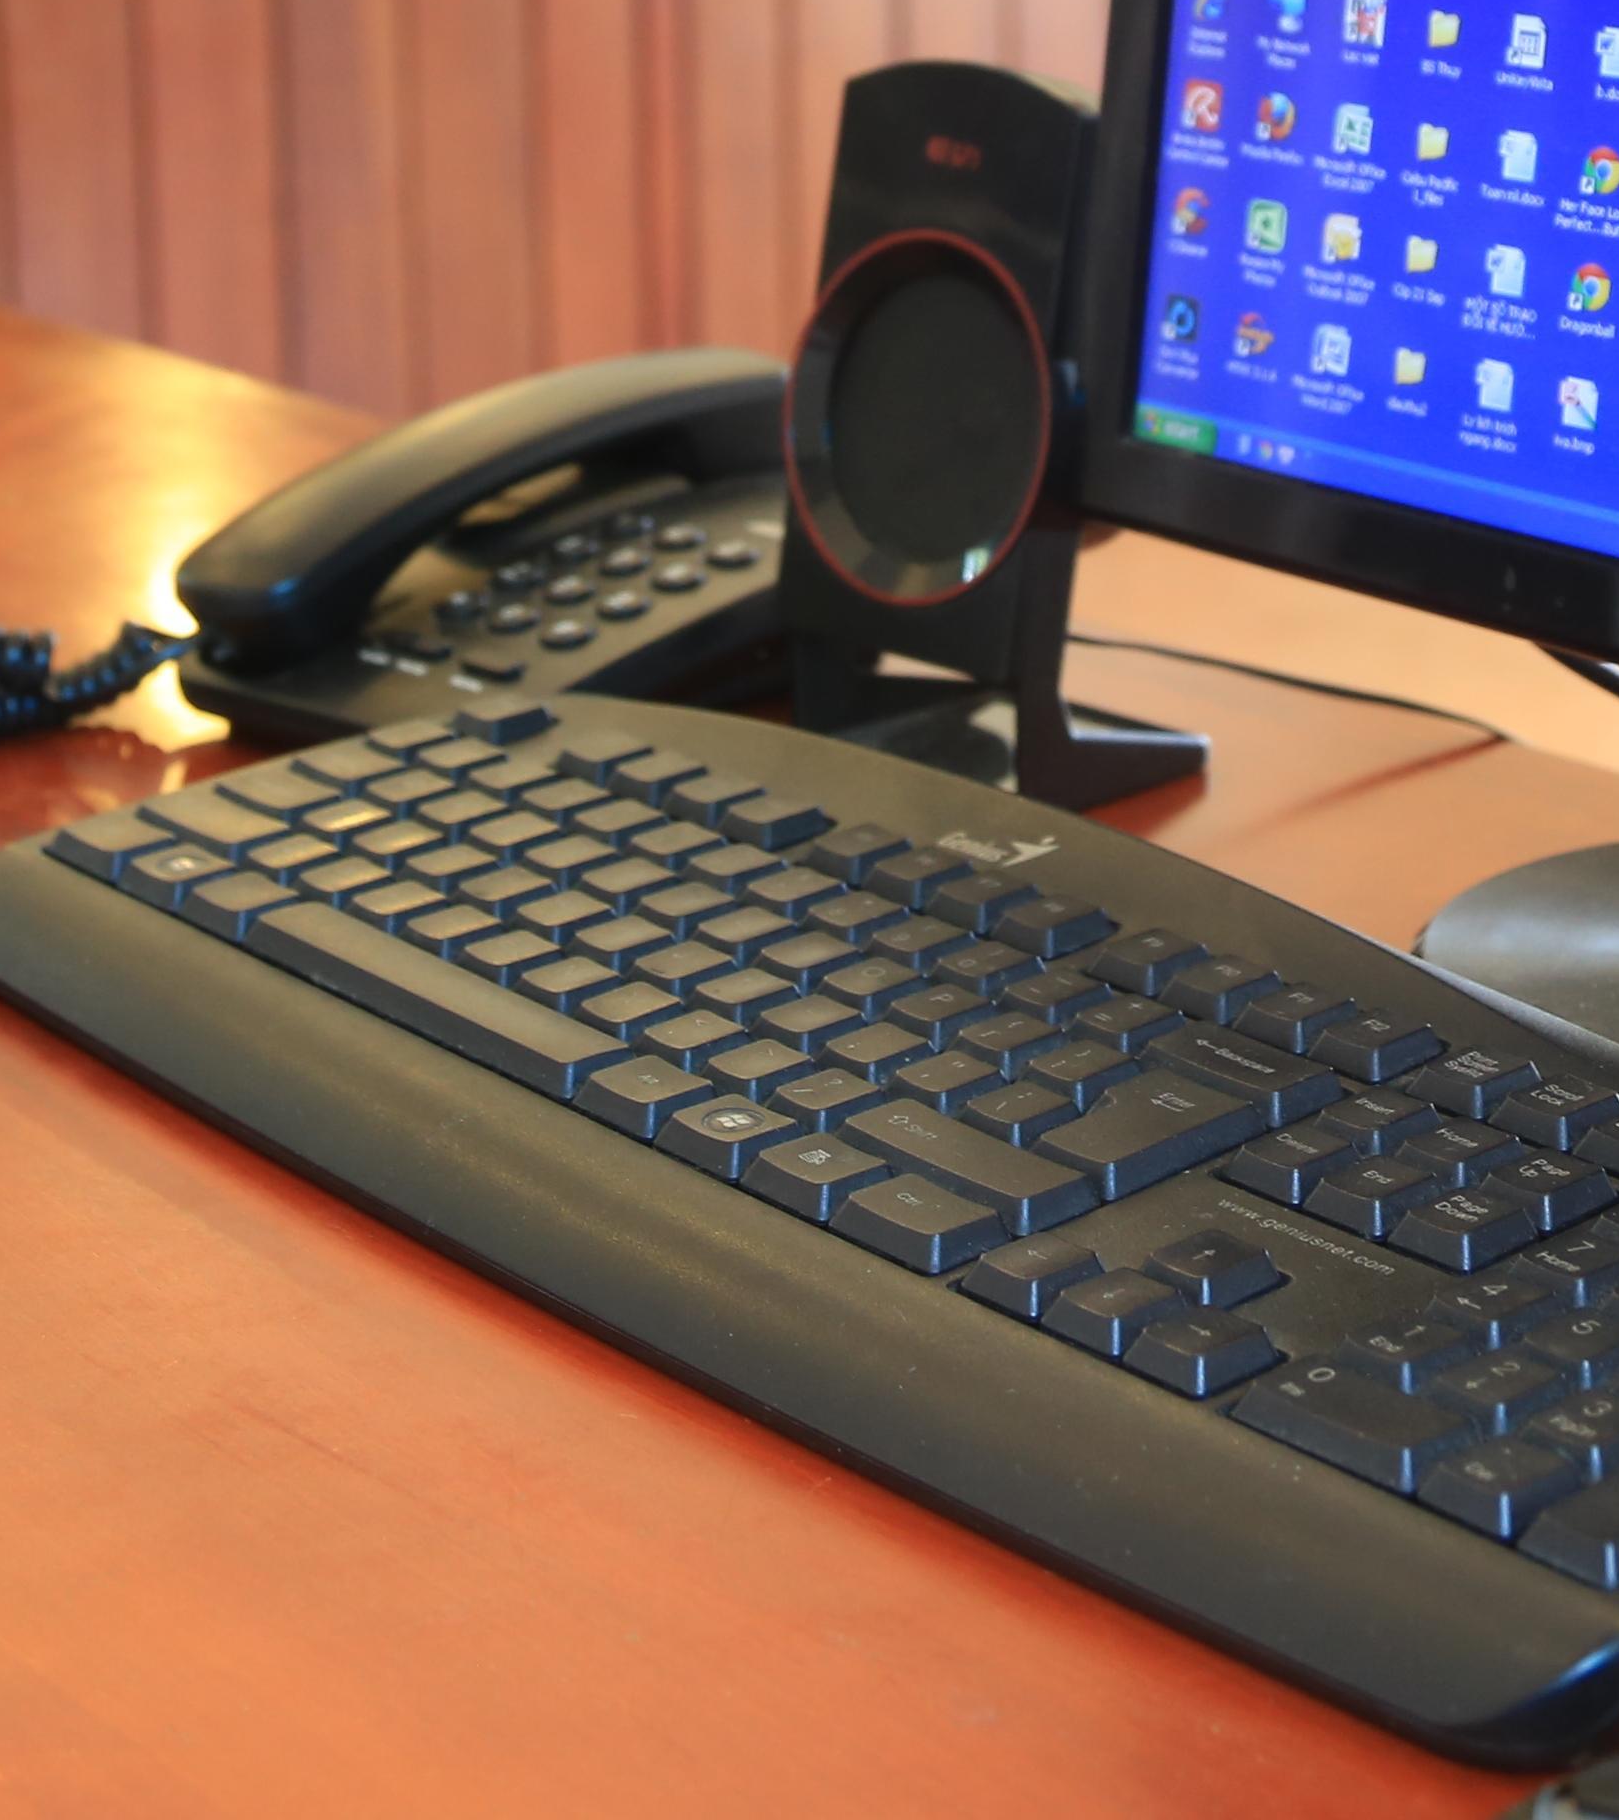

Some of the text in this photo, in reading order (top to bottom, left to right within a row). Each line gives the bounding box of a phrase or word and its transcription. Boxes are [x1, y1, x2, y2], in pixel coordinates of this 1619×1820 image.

[1581, 201, 1606, 219] Face
[1559, 316, 1615, 338] Dragonball
[930, 992, 954, 1002] P
[1355, 1097, 1396, 1116] Insert
[1531, 1090, 1564, 1107] Lock
[1436, 1127, 1478, 1148] Home
[1519, 1165, 1538, 1179] Up
[1532, 1158, 1570, 1177] Page
[1362, 1169, 1393, 1184] End
[1434, 1201, 1478, 1223] Down
[1450, 1195, 1489, 1214] Page
[1218, 1198, 1396, 1276] www.geniusnet.com
[1567, 1240, 1596, 1252] 7
[1536, 1250, 1581, 1273] Home
[1482, 1283, 1508, 1296] 4
[1572, 1319, 1601, 1335] 5
[1308, 1367, 1336, 1383] 0
[1491, 1362, 1521, 1377] 2
[1583, 1400, 1613, 1417] 3
